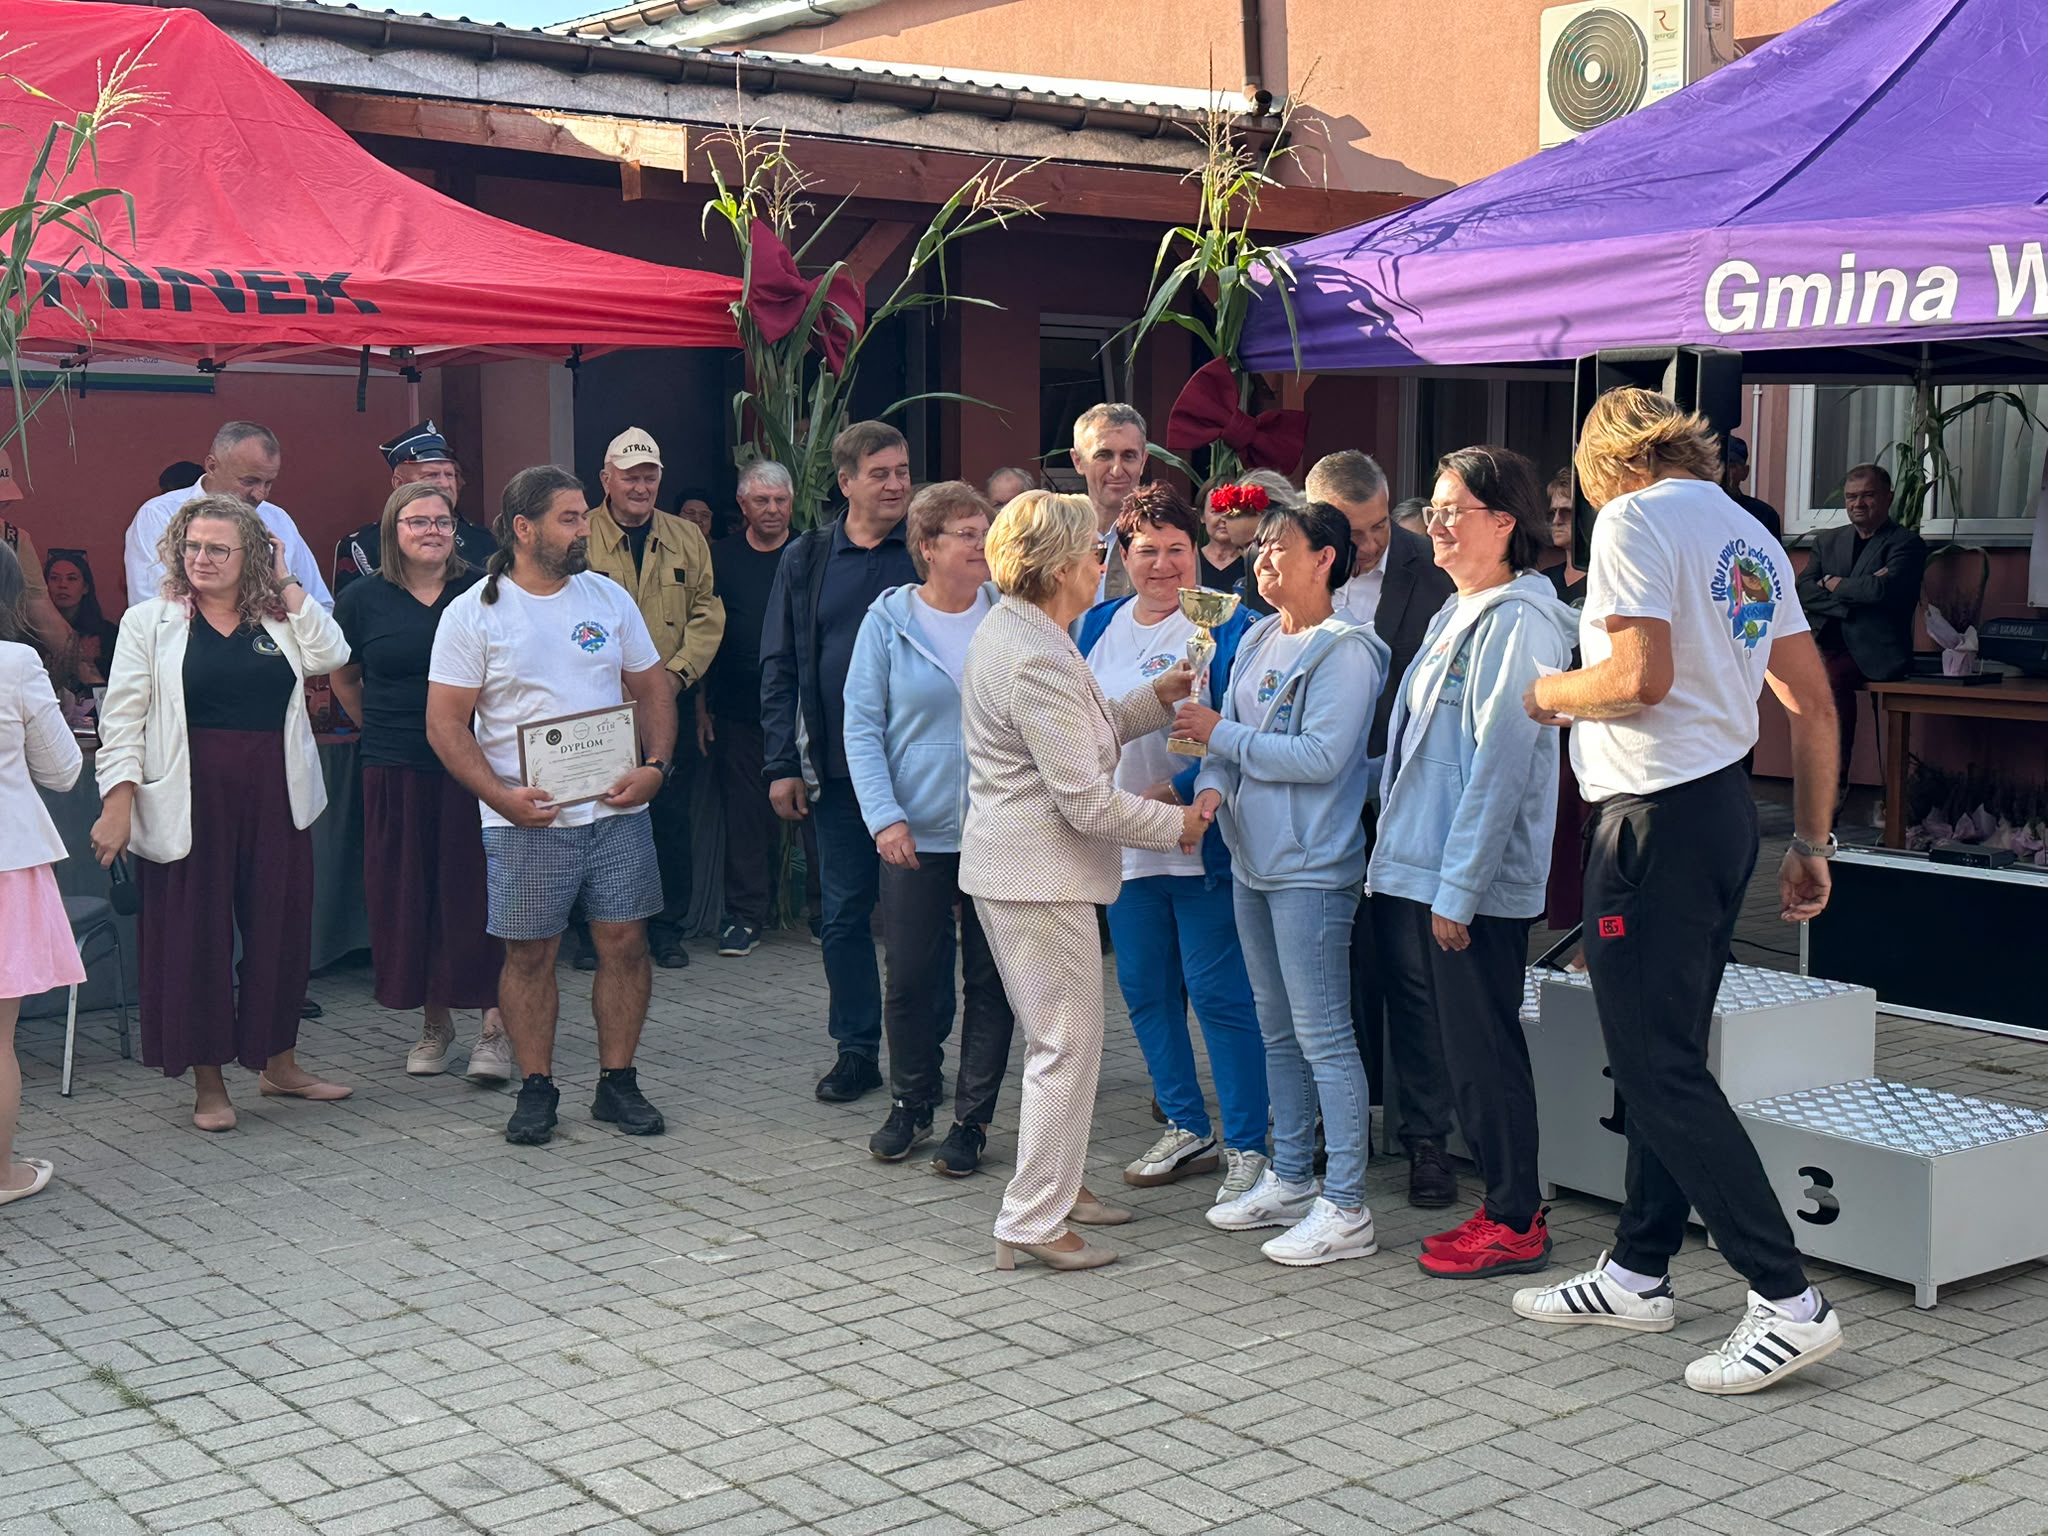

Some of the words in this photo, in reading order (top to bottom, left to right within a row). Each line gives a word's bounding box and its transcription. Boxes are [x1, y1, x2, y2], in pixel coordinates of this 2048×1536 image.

[1704, 252, 1959, 335] Gmina
[1711, 568, 1727, 601] KGW
[560, 739, 603, 754] DYPLOM
[1796, 1166, 1840, 1226] 3
